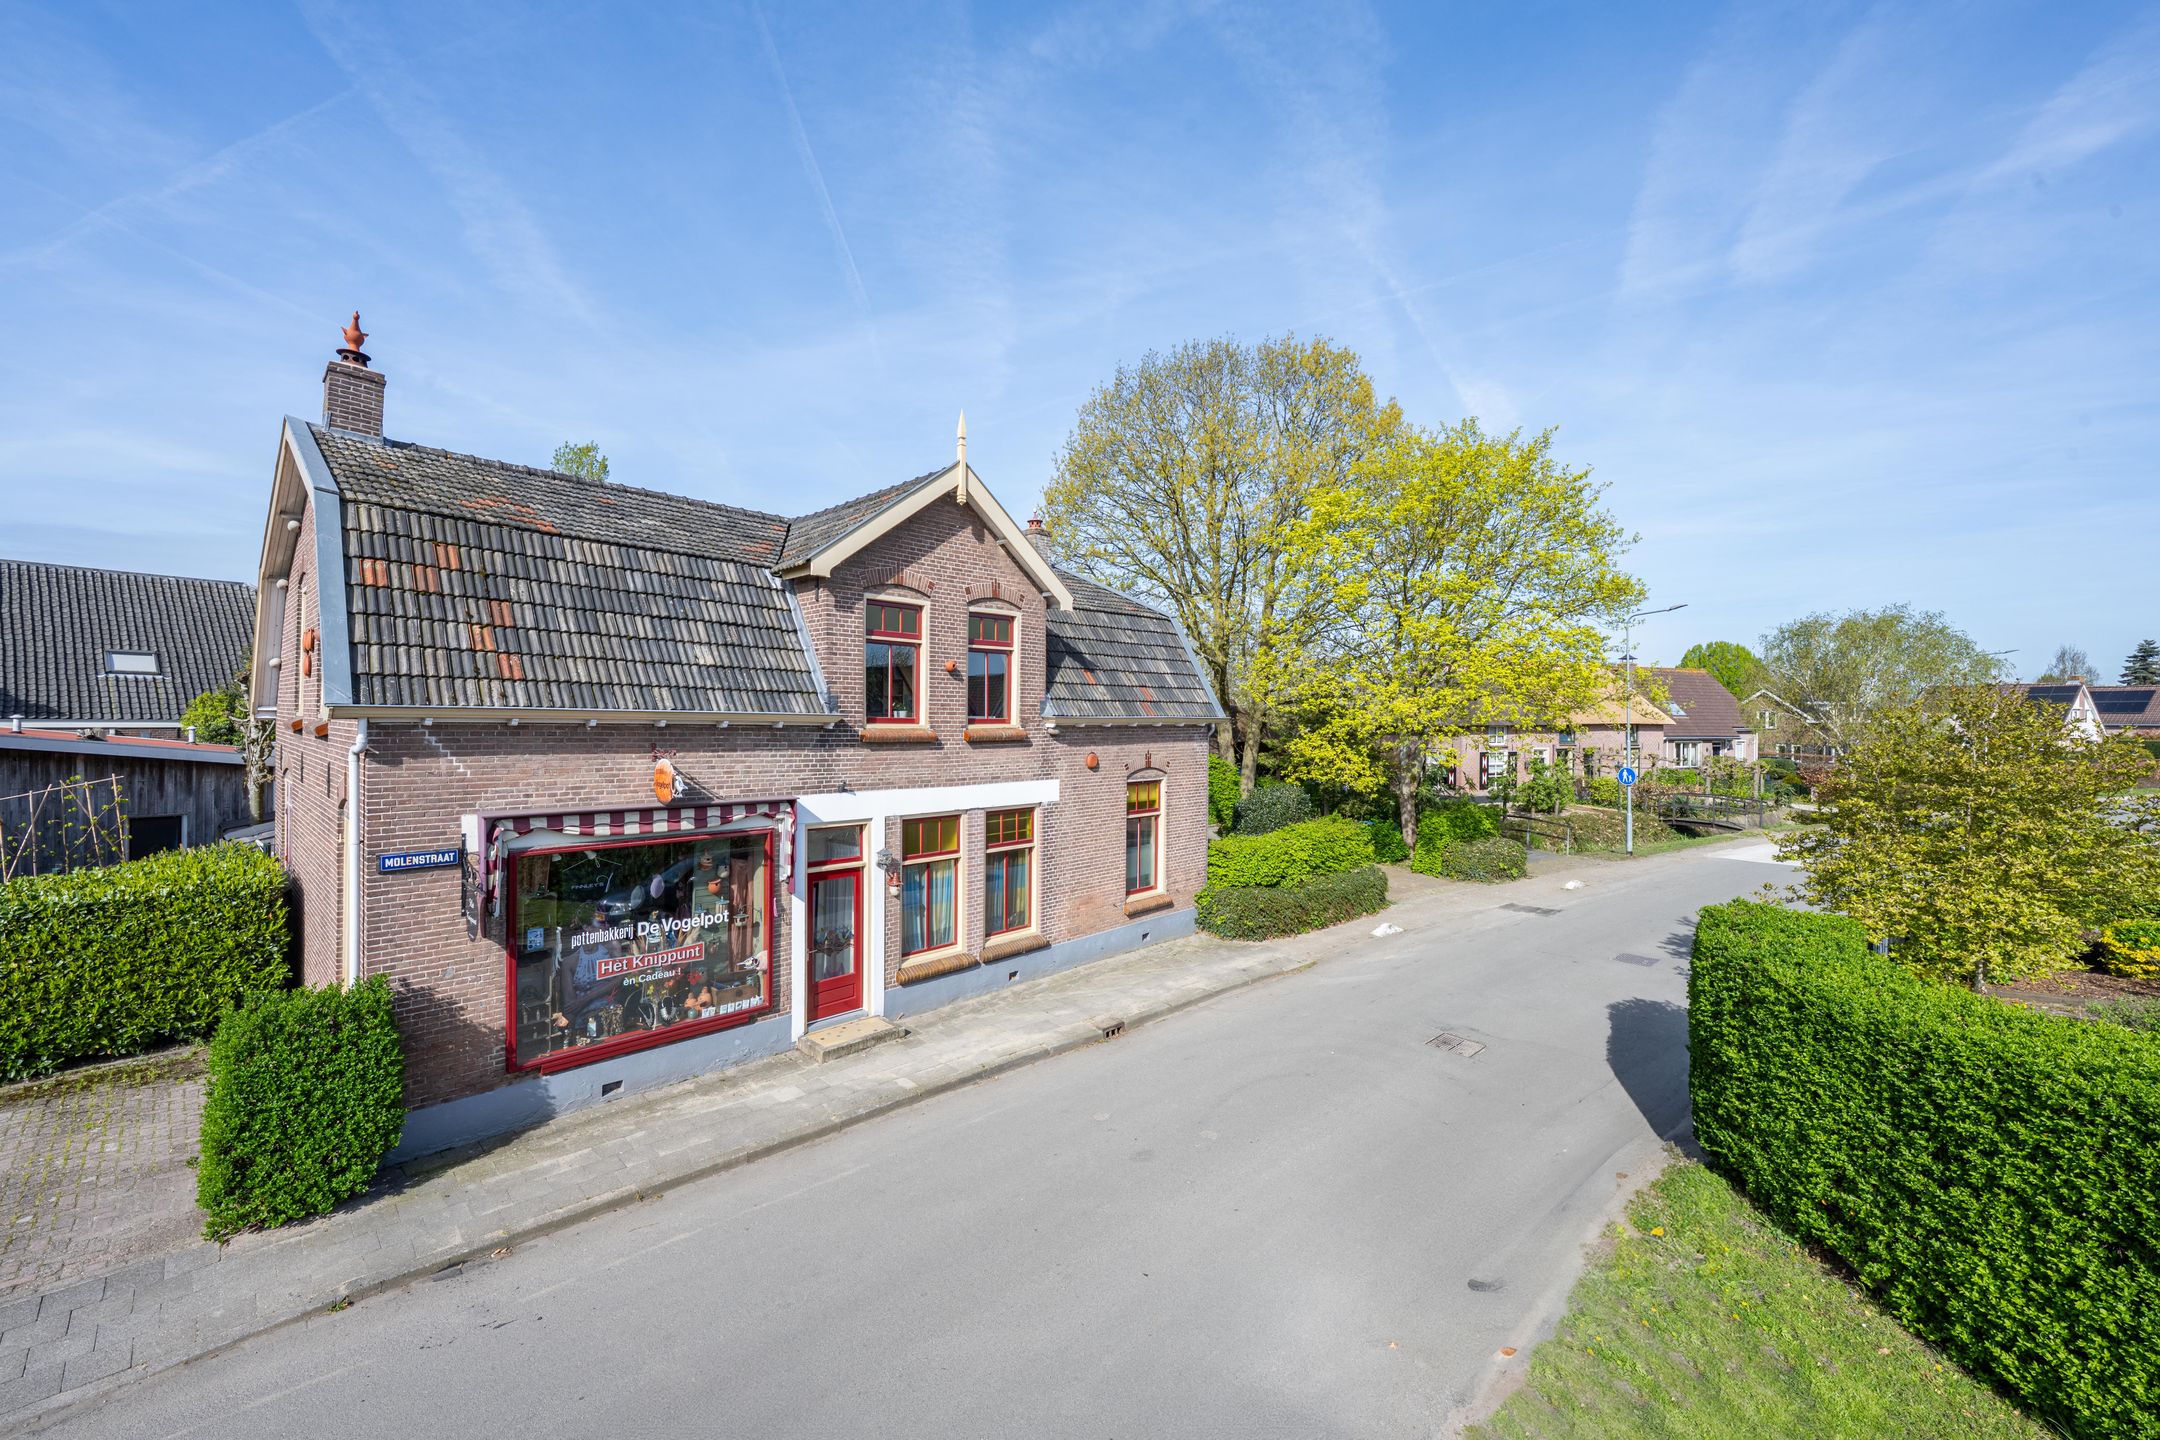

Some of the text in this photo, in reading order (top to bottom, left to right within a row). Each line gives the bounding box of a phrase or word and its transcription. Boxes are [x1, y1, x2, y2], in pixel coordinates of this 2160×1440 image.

[385, 852, 455, 868] MOLENSTRAAT
[571, 924, 634, 949] pottenbakkerij
[637, 921, 660, 937] De
[661, 909, 730, 933] Vogelpot
[632, 945, 701, 969] Knippunt
